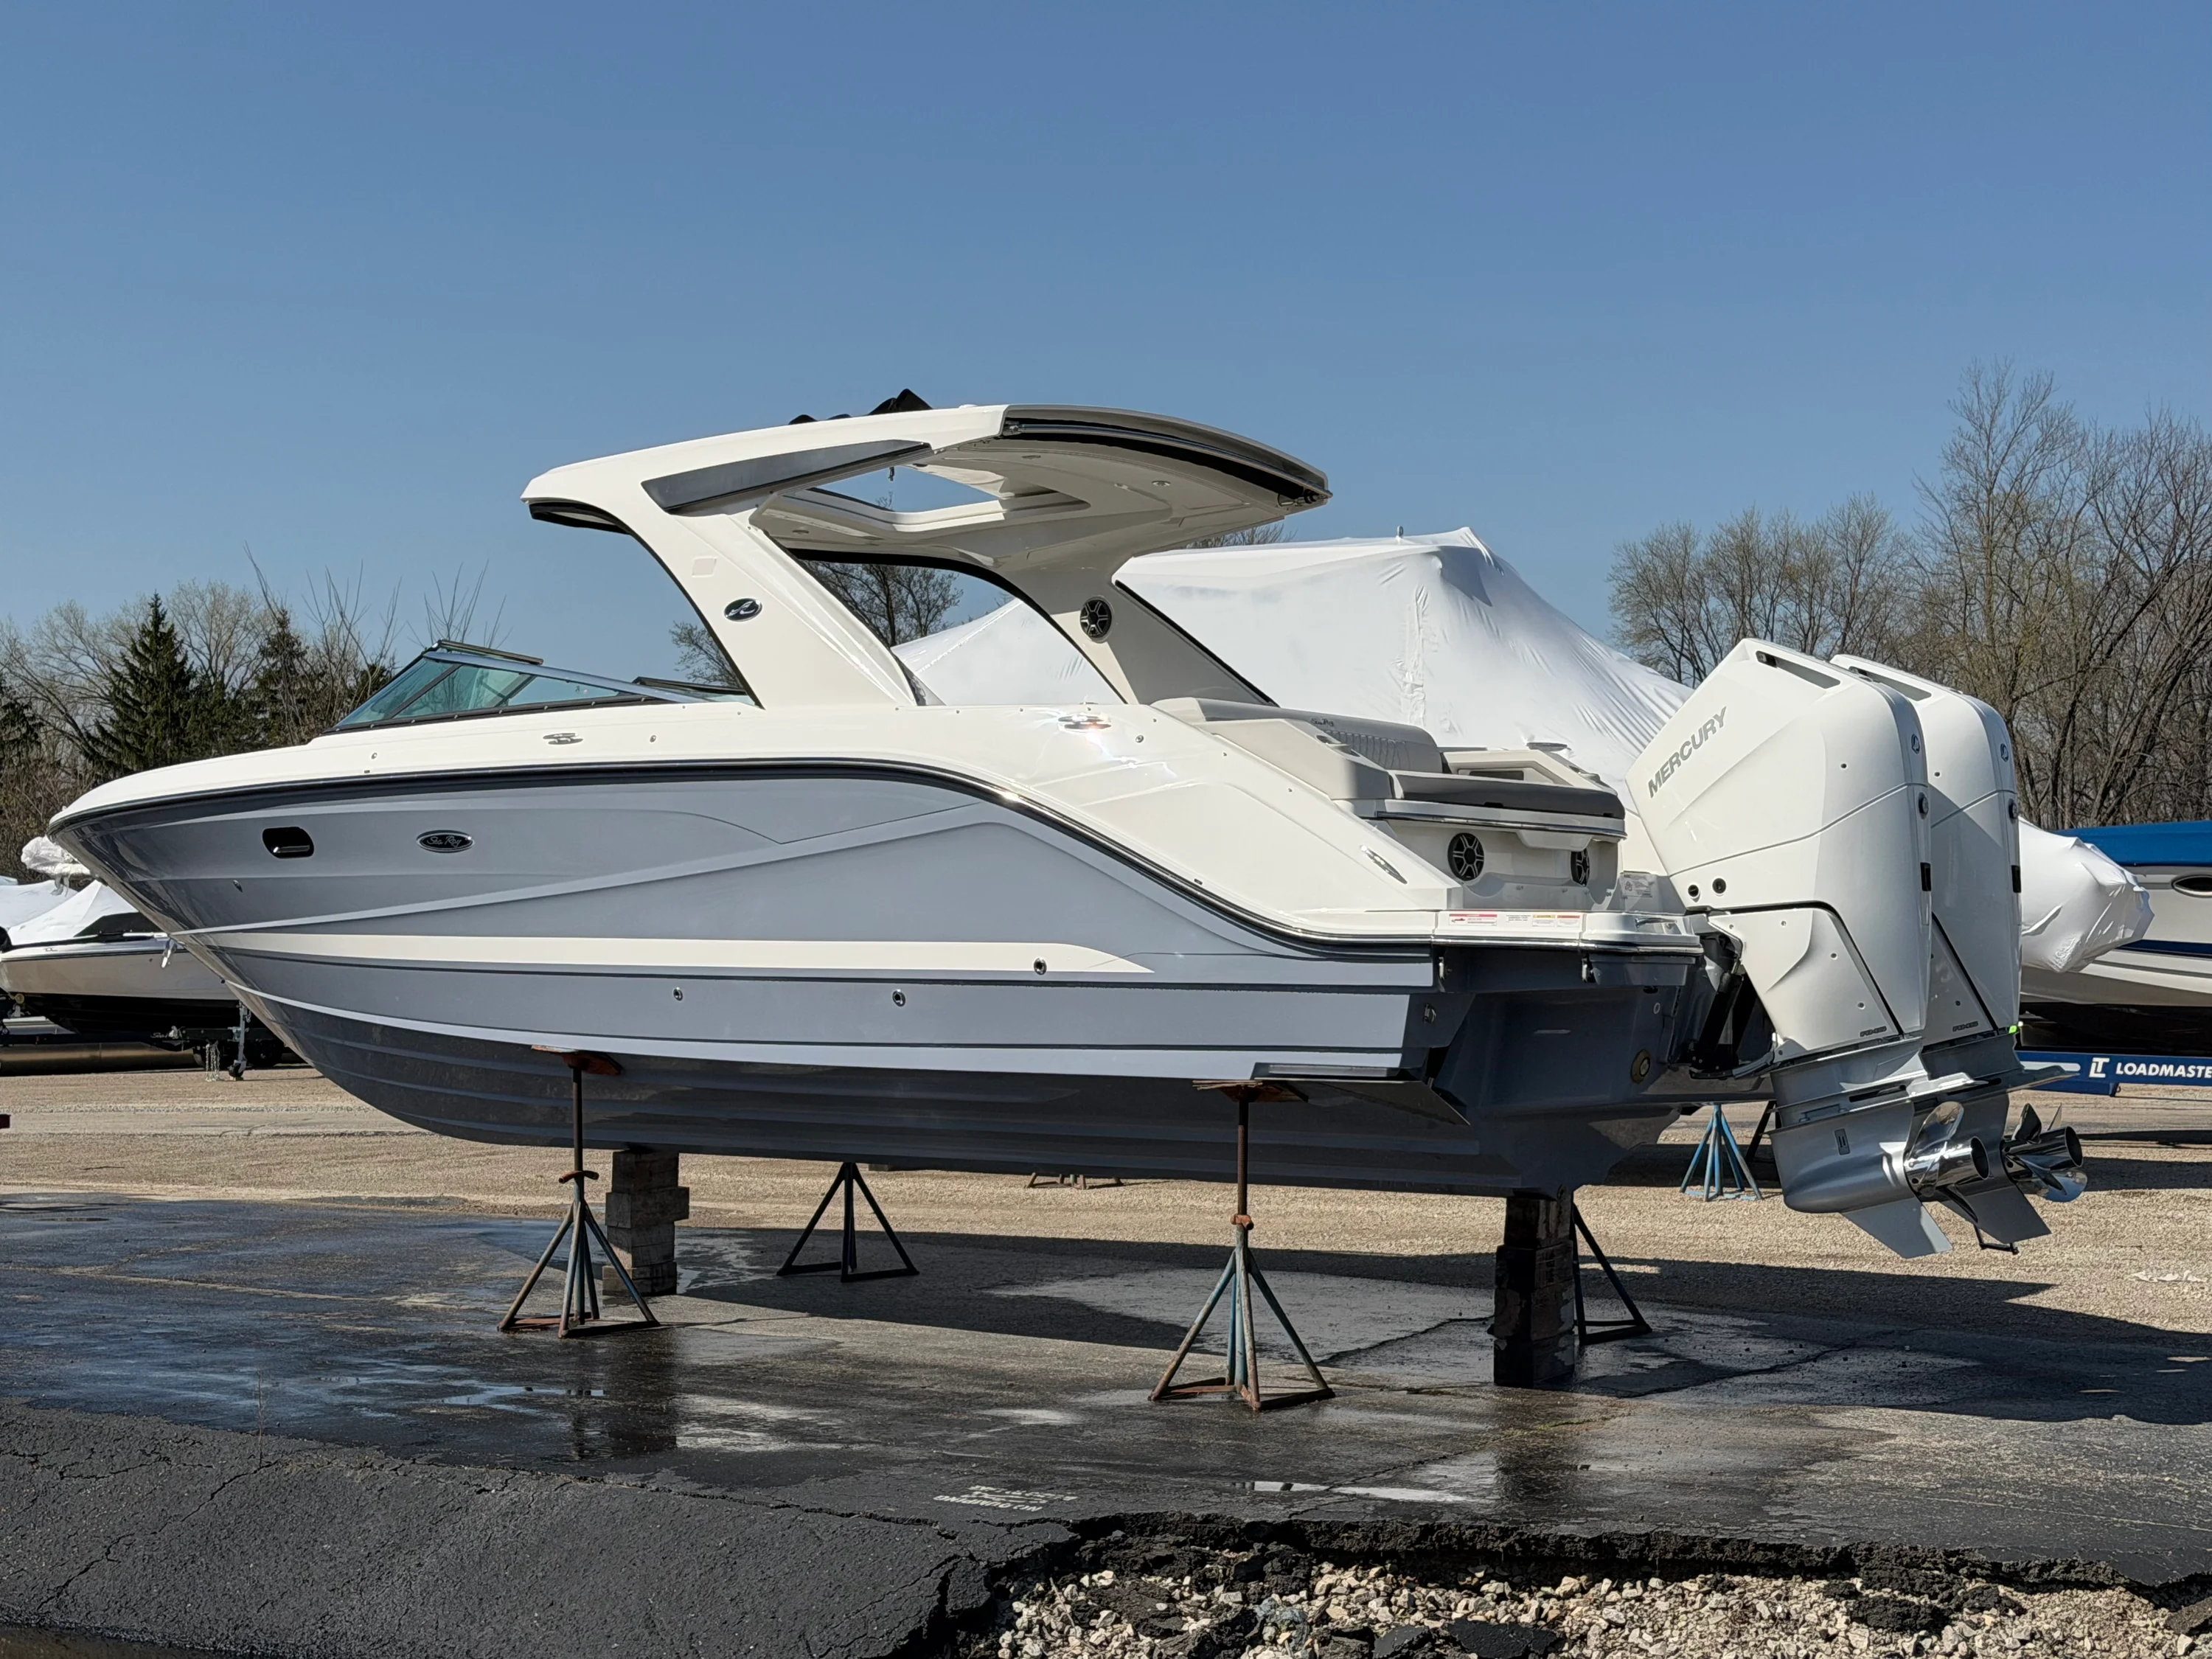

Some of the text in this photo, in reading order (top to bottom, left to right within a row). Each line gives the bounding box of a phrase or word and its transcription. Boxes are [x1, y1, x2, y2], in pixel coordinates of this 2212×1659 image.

[1648, 706, 1727, 799] MERCURY
[426, 835, 462, 847] Sea Ray
